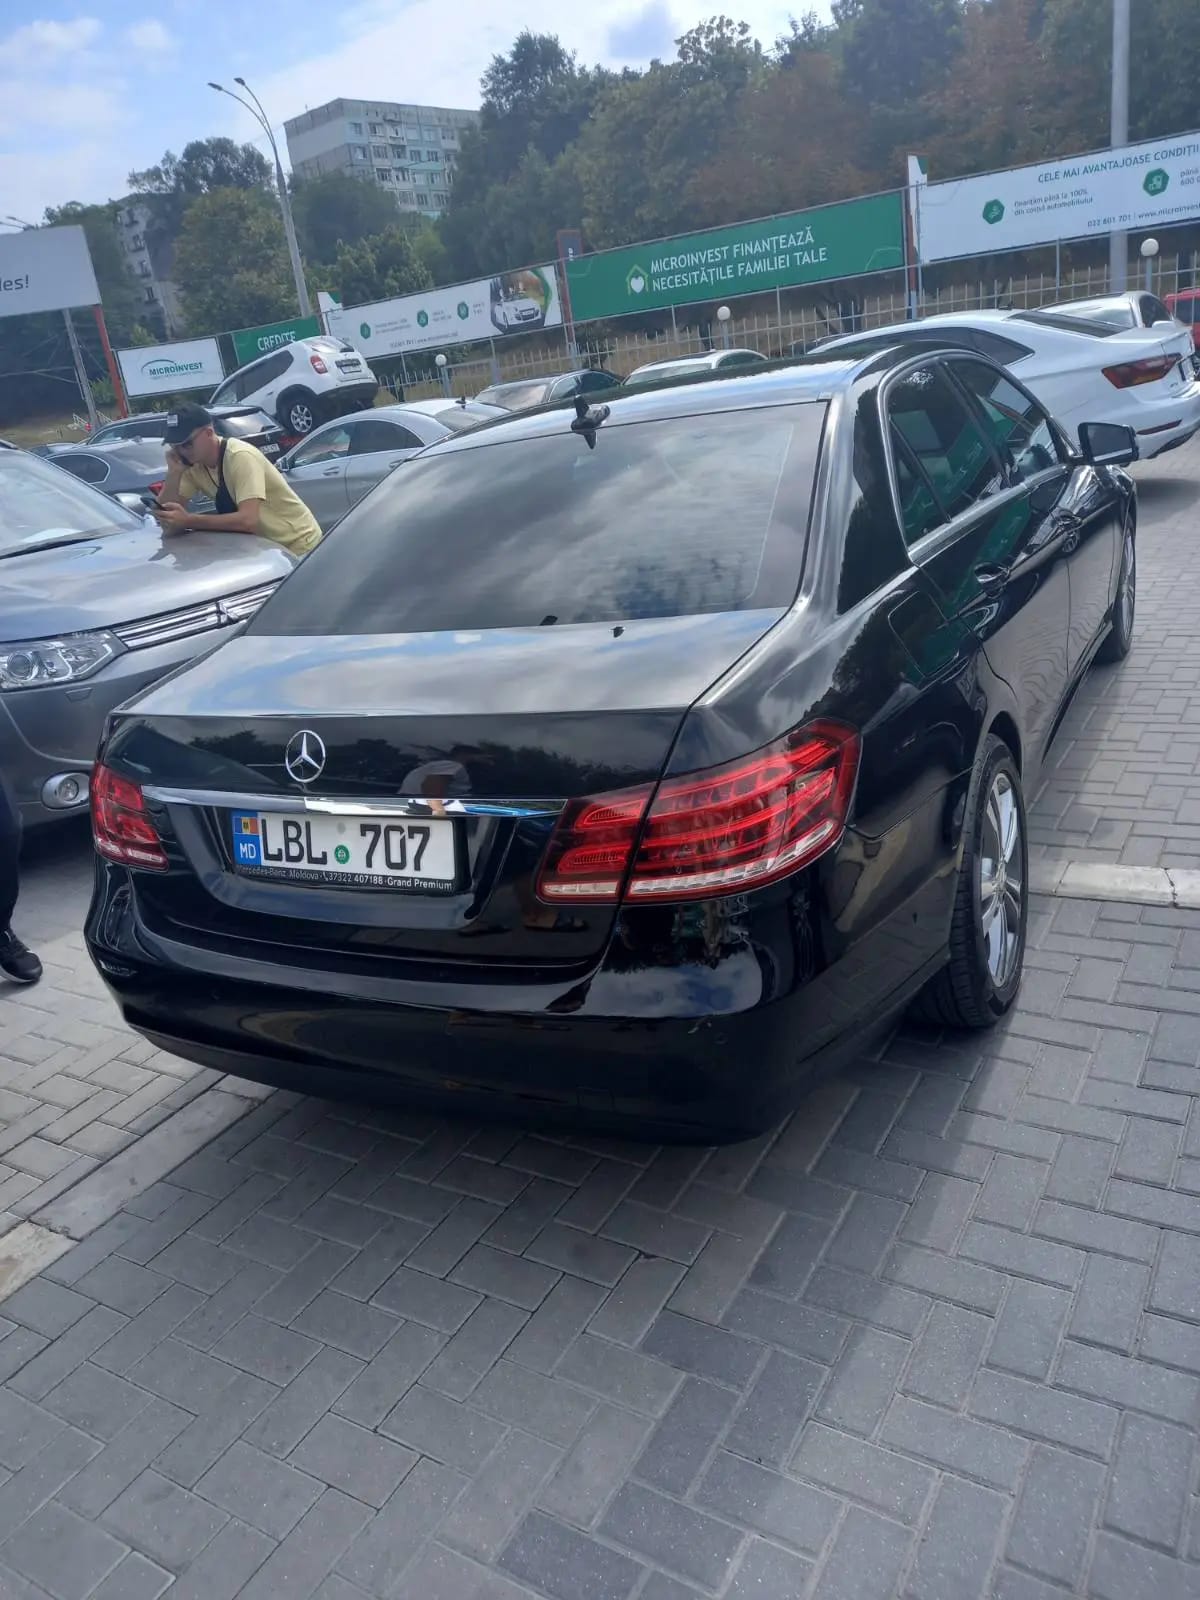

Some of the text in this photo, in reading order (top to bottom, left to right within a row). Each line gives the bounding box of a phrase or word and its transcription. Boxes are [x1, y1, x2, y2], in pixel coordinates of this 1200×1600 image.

[1038, 171, 1060, 183] CELE
[1063, 168, 1080, 179] MAI
[1083, 154, 1151, 175] AVANTAJOASE
[651, 226, 814, 274] MICROINVEST FINANȚEAZĂ
[652, 247, 828, 291] NECESITĂȚILE FAMILIEI TALE
[240, 842, 257, 859] MD
[261, 818, 431, 872] LBL 707
[289, 869, 319, 880] Moldova
[354, 875, 383, 885] 407188
[387, 876, 412, 887] Grand
[414, 879, 452, 890] Premium
